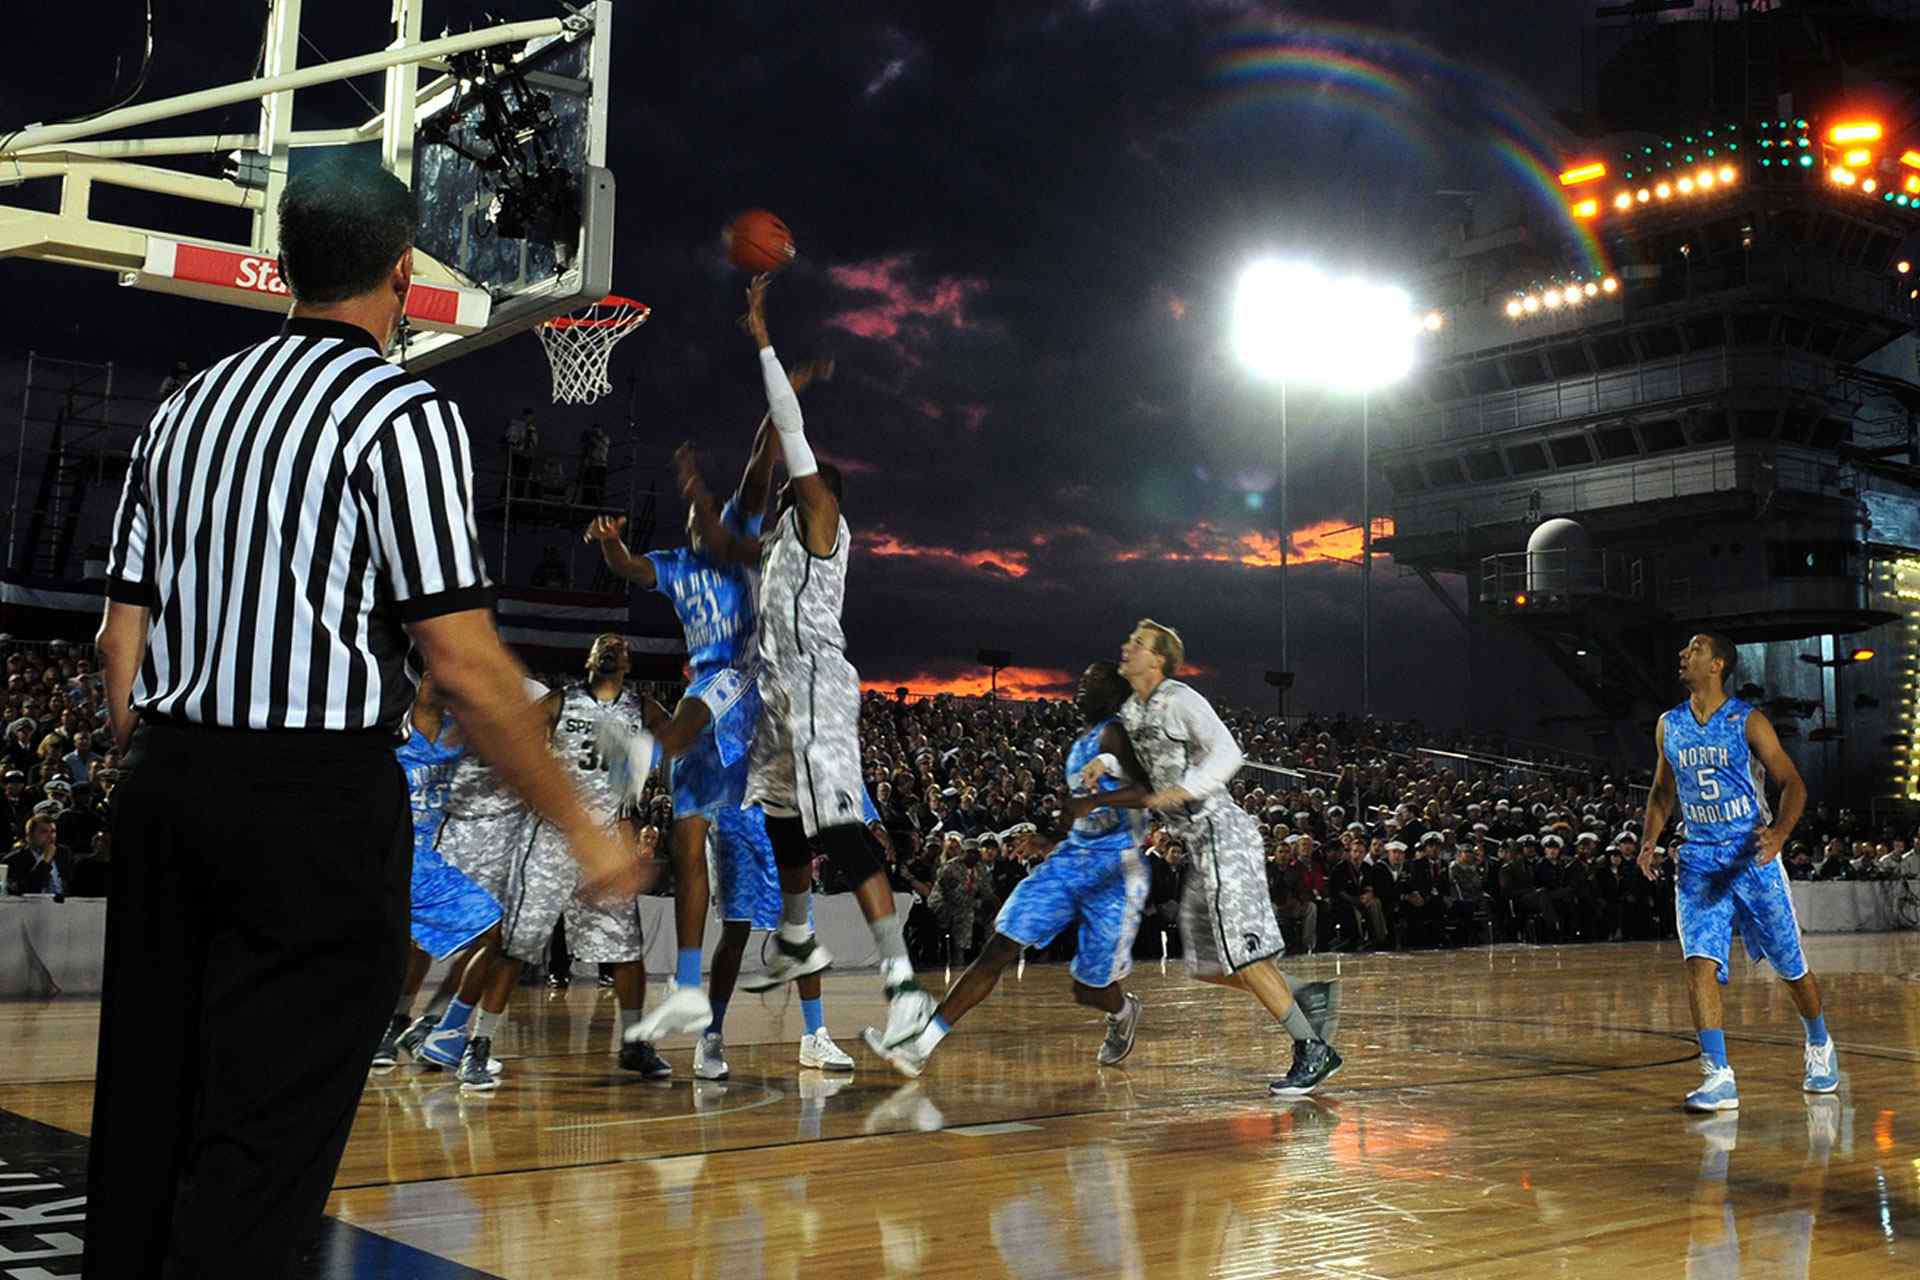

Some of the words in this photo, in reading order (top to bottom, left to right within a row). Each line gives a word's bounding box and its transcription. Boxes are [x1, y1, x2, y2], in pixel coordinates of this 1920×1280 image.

[686, 588, 722, 625] 31
[1678, 746, 1728, 768] NORTH
[1696, 768, 1720, 801] 5
